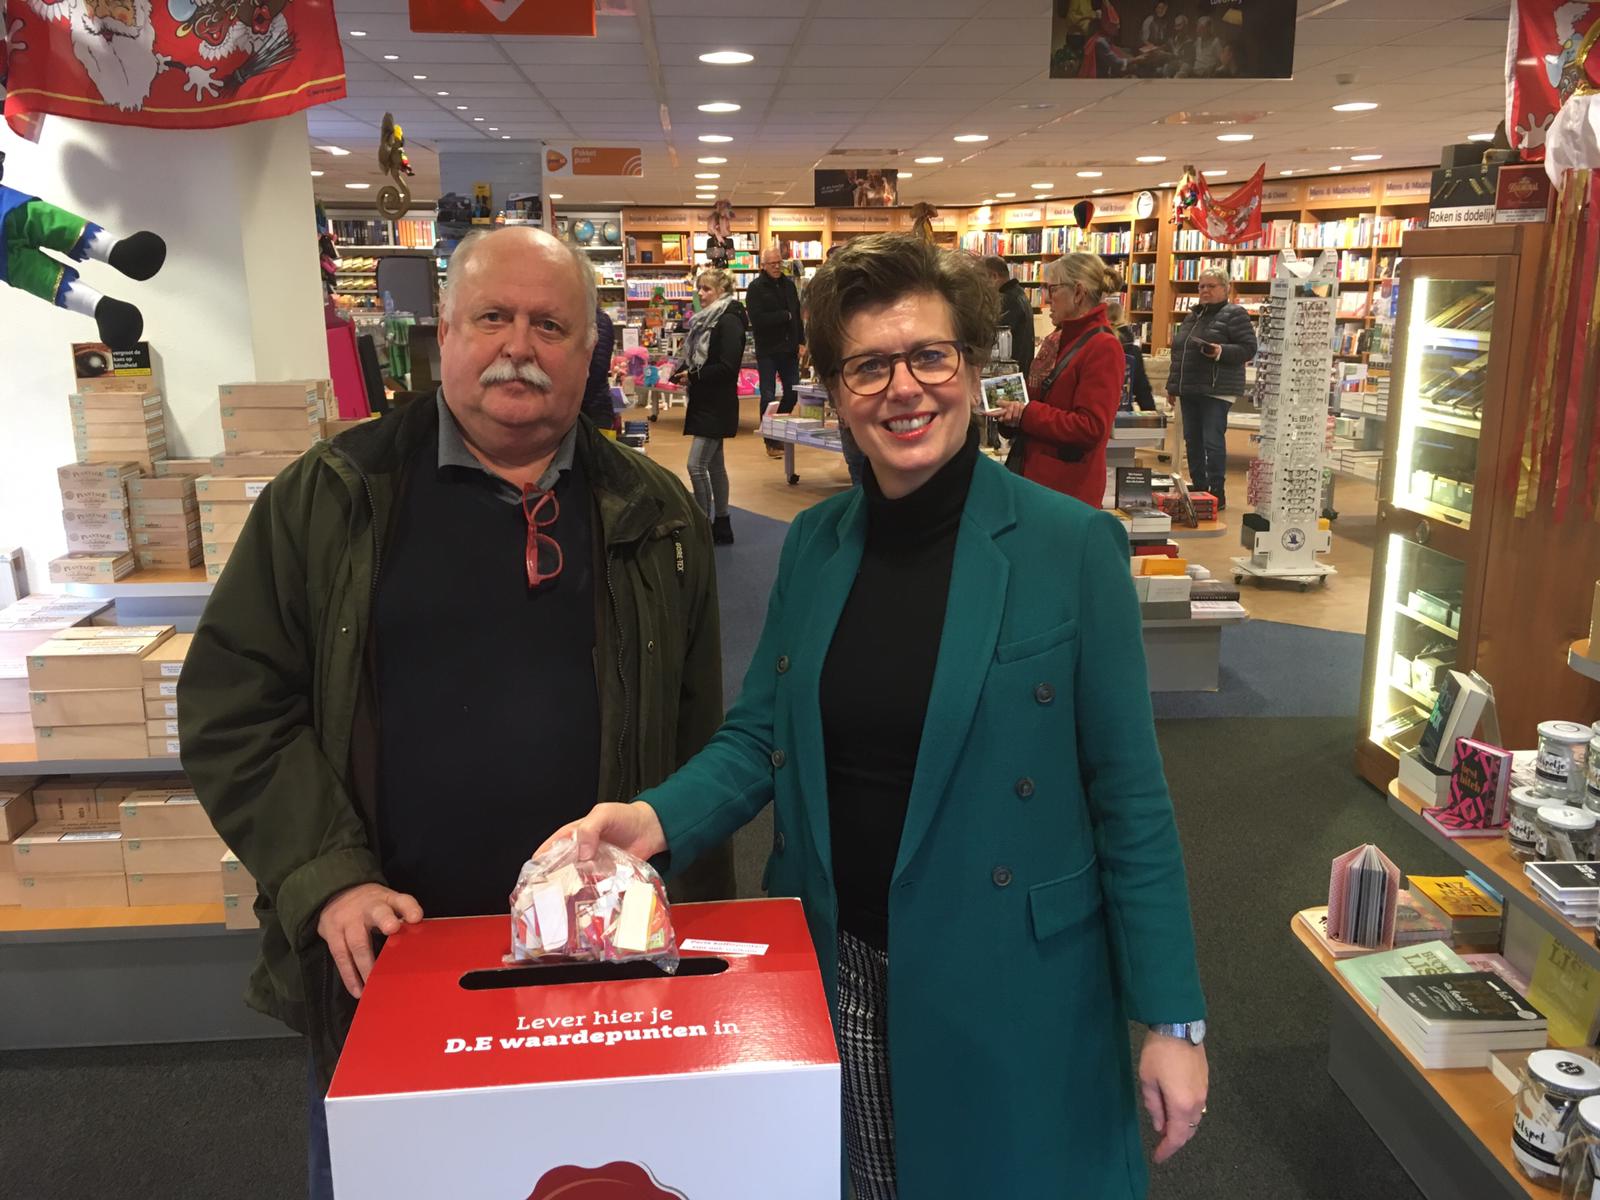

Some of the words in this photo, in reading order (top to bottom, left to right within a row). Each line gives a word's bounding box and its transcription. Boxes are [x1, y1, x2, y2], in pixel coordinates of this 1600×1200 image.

[1430, 211, 1454, 223] Roken
[1455, 209, 1463, 220] is
[1464, 206, 1496, 223] dodelijk
[516, 1013, 587, 1031] Lever
[593, 1009, 645, 1026] hier
[649, 1007, 674, 1025] je
[444, 1035, 494, 1053] D.E
[499, 1024, 708, 1050] waardepunten
[713, 1020, 741, 1036] in
